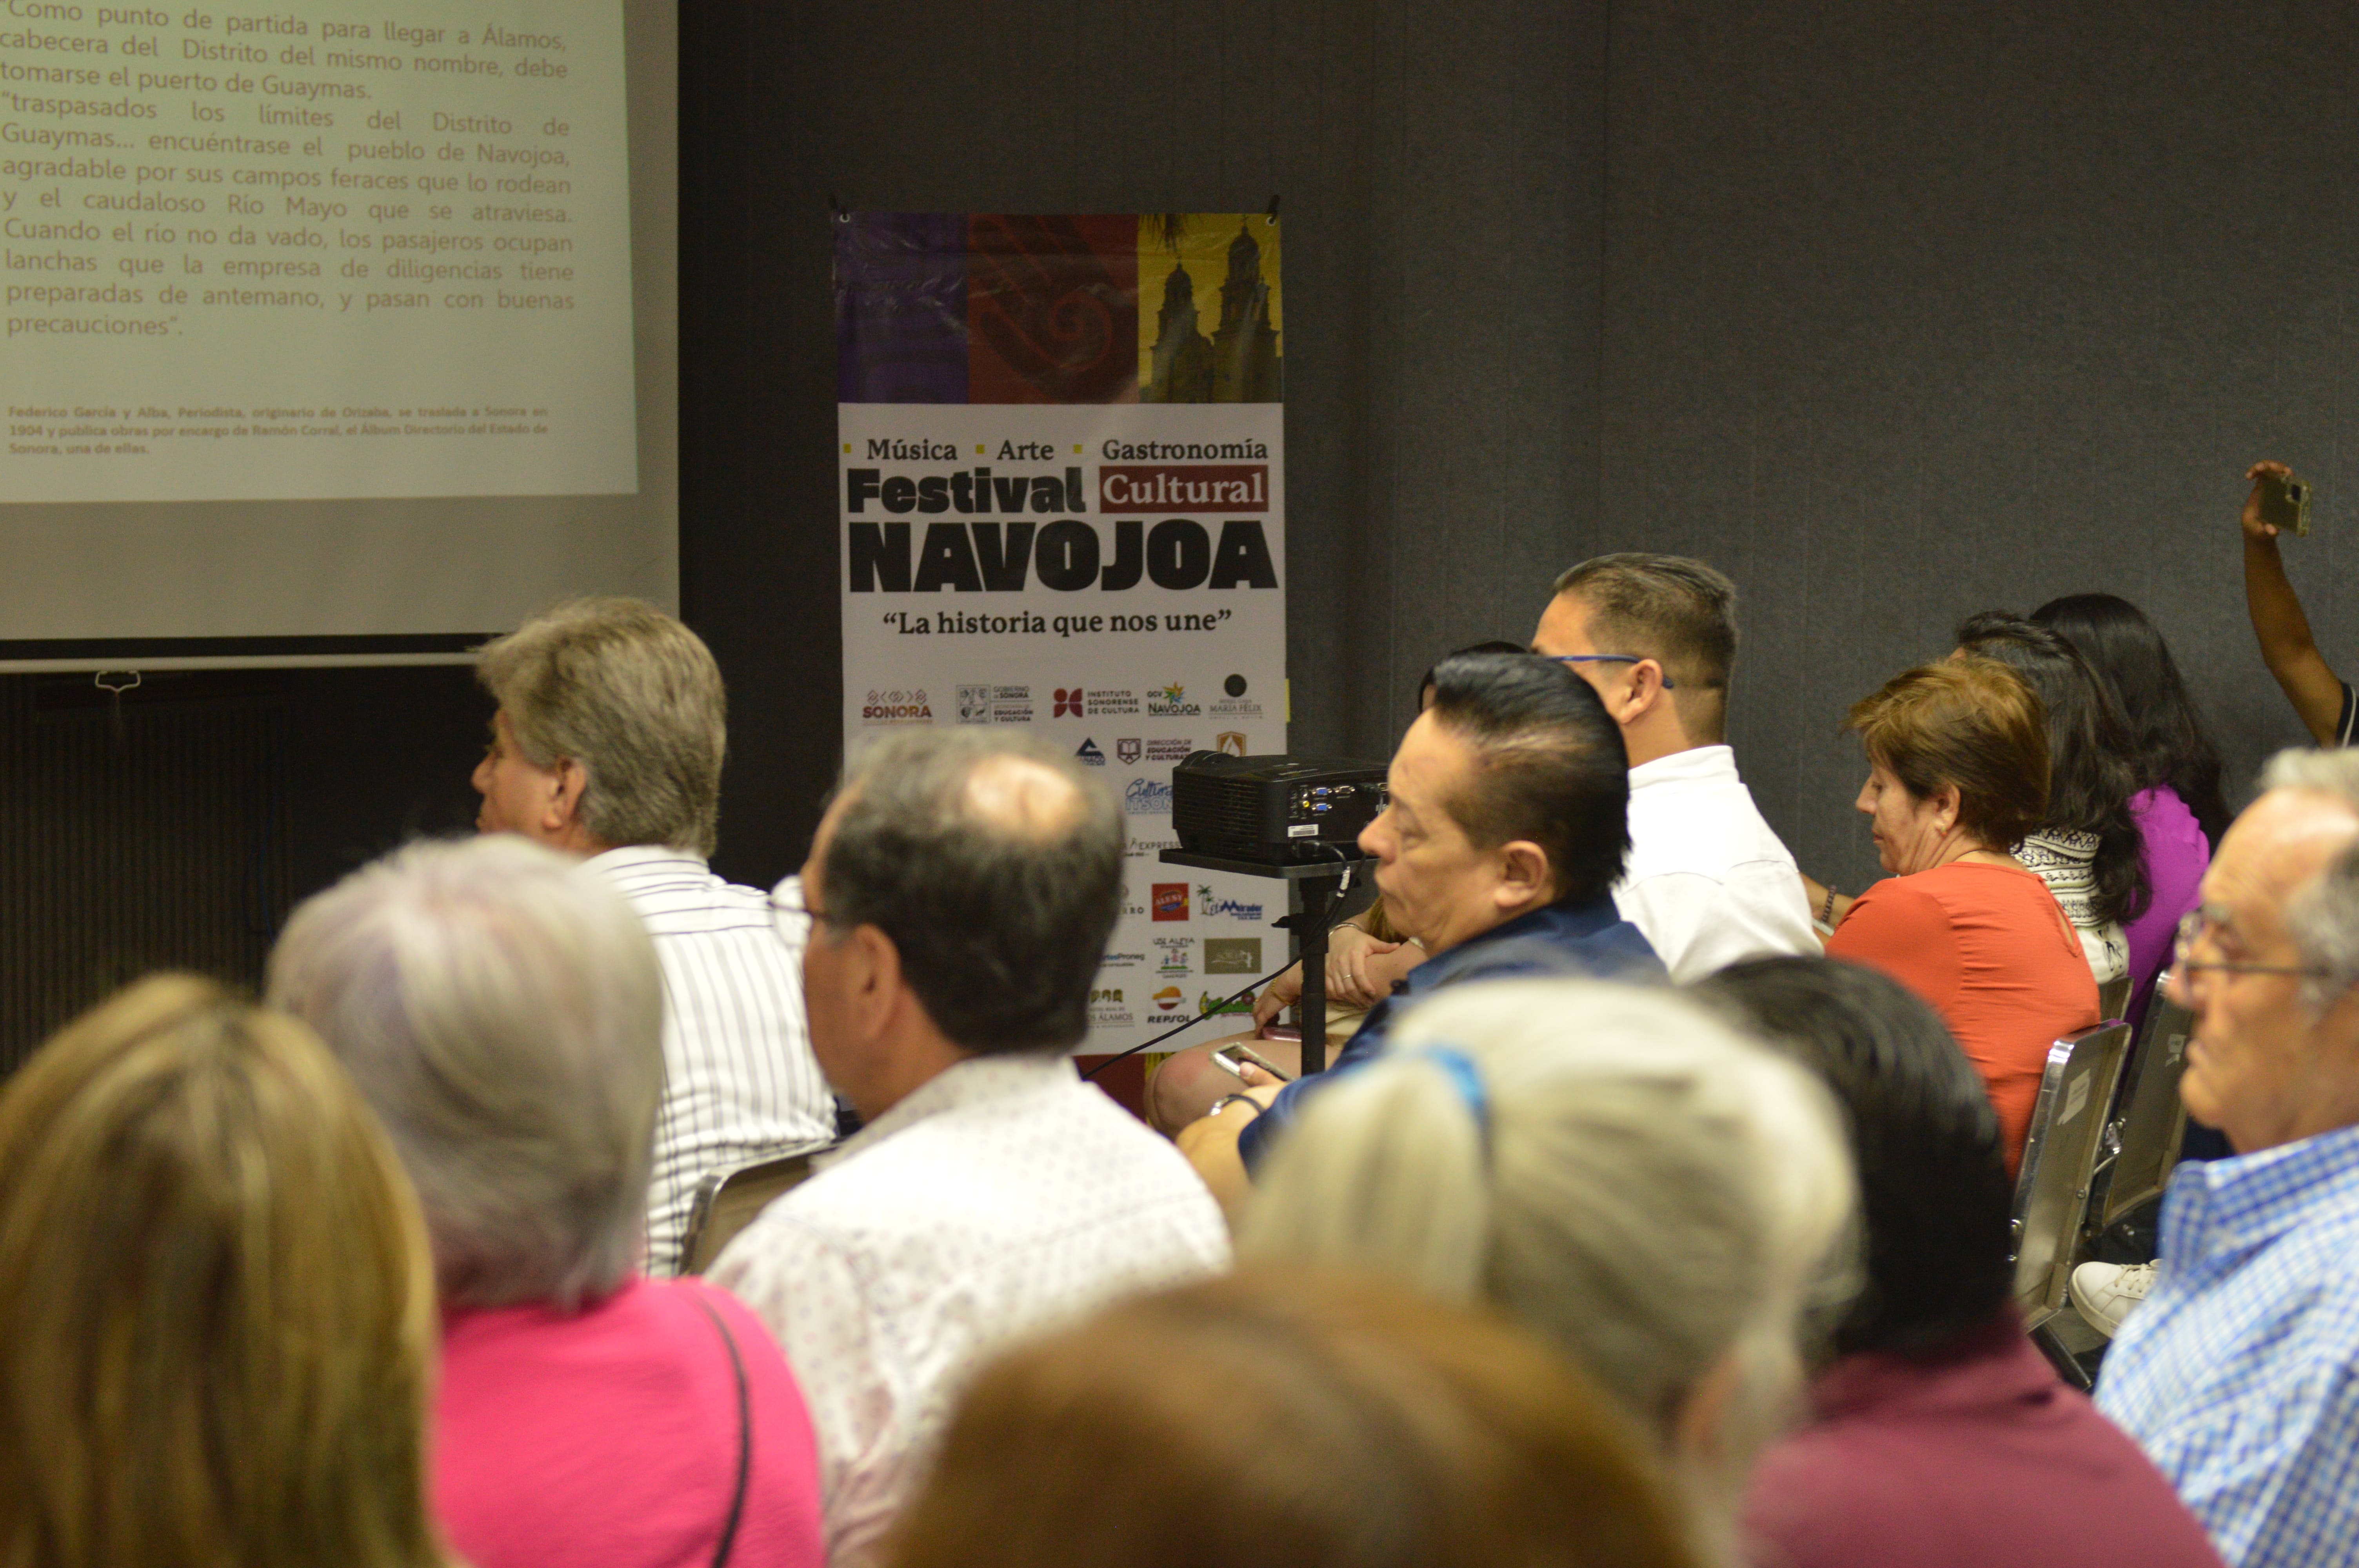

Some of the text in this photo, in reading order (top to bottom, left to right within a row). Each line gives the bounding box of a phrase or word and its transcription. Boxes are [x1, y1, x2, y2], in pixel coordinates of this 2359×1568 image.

[98, 8, 169, 28] punto
[183, 8, 212, 29] de
[227, 15, 308, 36] partida
[322, 23, 371, 42] para
[384, 20, 445, 48] llegar
[458, 30, 470, 44] a
[482, 22, 567, 52] Álamos,
[0, 28, 568, 79] cabecera del Distrito del mismo nombre, debe
[0, 62, 371, 102] tomarse el puerto de Guaymas.
[192, 100, 225, 122] los
[259, 104, 334, 127] límites
[367, 110, 401, 130] del
[433, 111, 513, 134] Distrito
[543, 117, 570, 136] de
[148, 132, 291, 155] encuéntrase
[303, 136, 323, 156] el
[348, 140, 425, 162] pueblo
[437, 142, 465, 161] de
[477, 143, 569, 169] Navojoa,
[3, 157, 571, 195] agradable por sus campos feraces que lo rodean
[3, 191, 17, 211] y
[40, 187, 61, 208] el
[83, 191, 206, 213] caudaloso
[286, 196, 347, 222] Mayo
[368, 204, 409, 223] que
[429, 205, 453, 220] se
[472, 204, 572, 223] atraviesa.
[4, 218, 101, 241] Cuando
[112, 221, 134, 242] el
[187, 229, 217, 245] no
[228, 225, 256, 245] da
[267, 227, 328, 250] vado,
[339, 228, 372, 249] los
[382, 230, 483, 254] pasajeros
[493, 237, 573, 256] ocupan
[6, 248, 574, 284] lanchas que la empresa de diligencias tiene
[7, 283, 575, 313] preparadas de antemano, y pasan con buenas
[867, 438, 1268, 461] Música Arte Gastronomía
[847, 466, 1264, 514] Festival Cultural
[849, 518, 1279, 593] NAVOJOA
[883, 608, 1232, 637] “La historia que nos une”
[863, 705, 932, 719] SONORA
[1147, 1014, 1191, 1024] REPSOL
